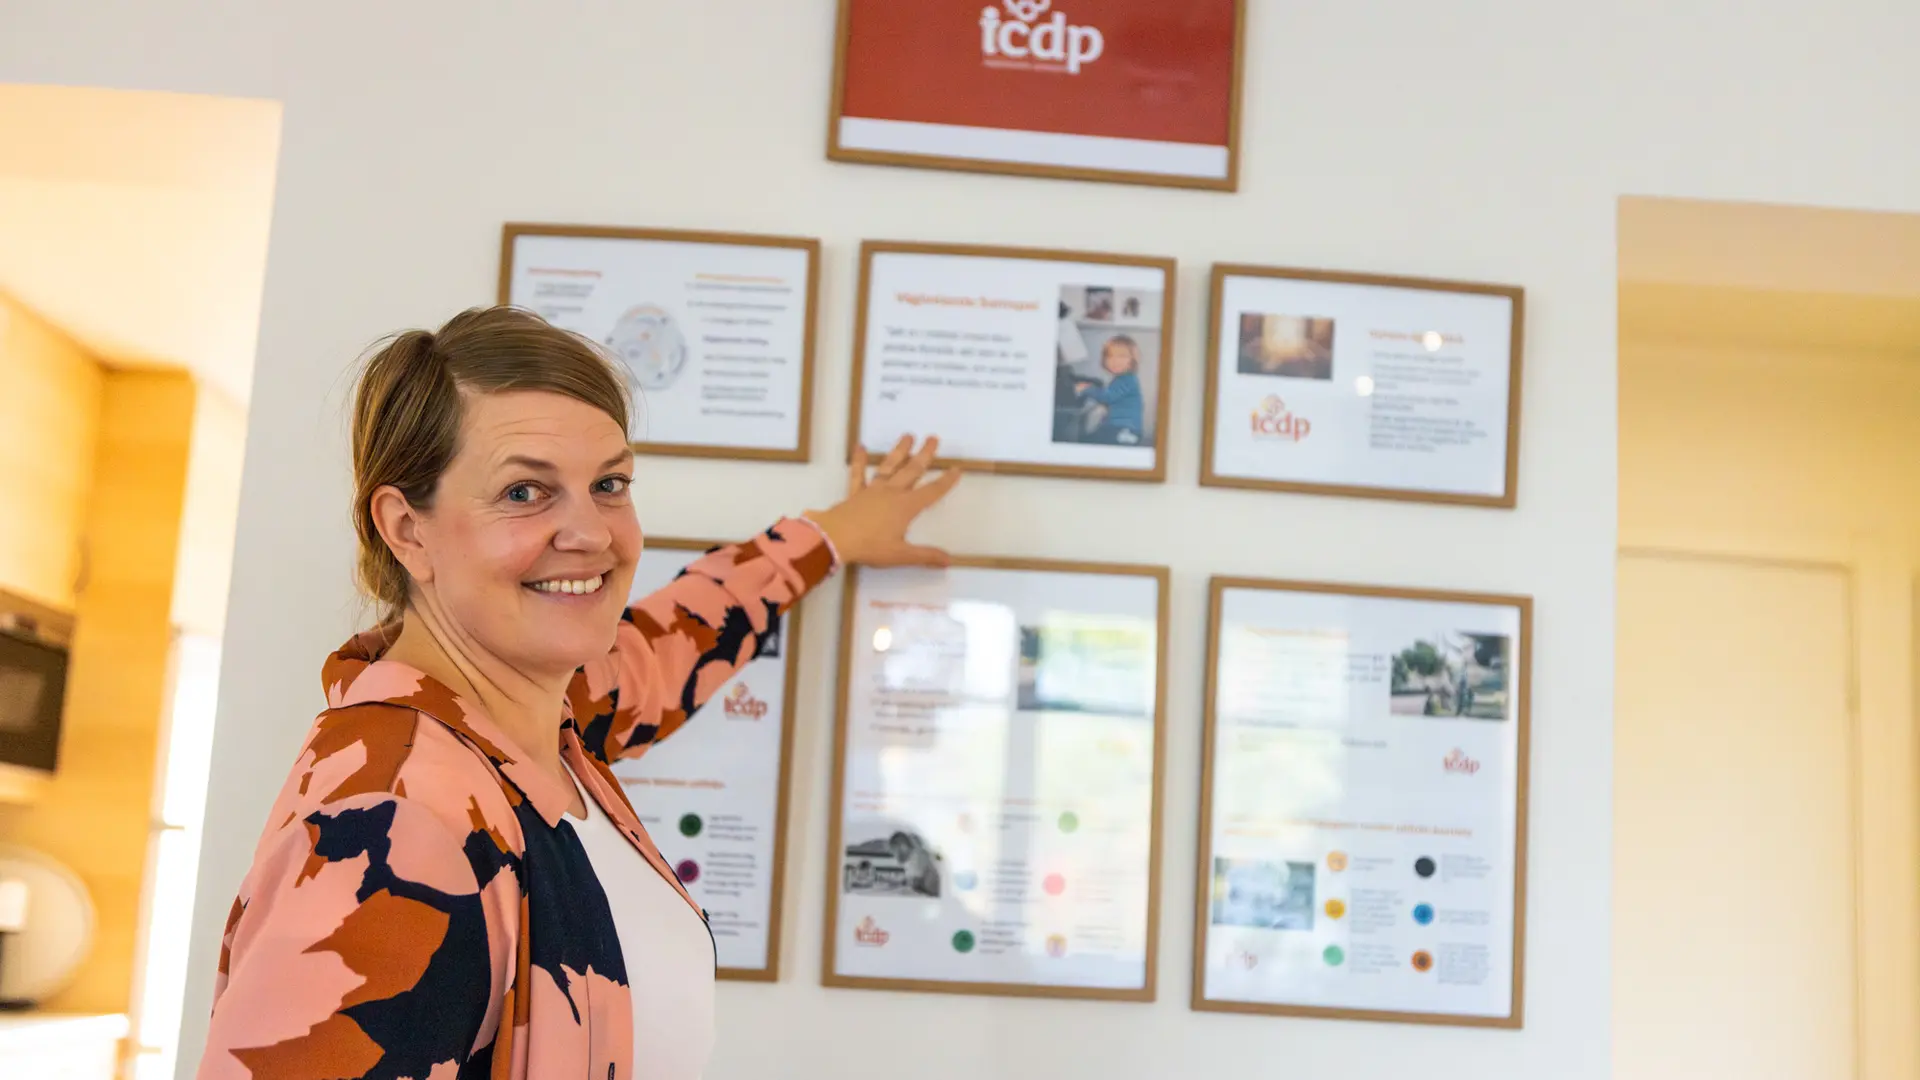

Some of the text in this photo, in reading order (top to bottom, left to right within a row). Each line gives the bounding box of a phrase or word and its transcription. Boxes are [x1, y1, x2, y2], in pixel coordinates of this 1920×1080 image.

[979, 6, 1104, 74] icdp
[1251, 409, 1311, 442] icdp
[723, 695, 768, 720] icdp
